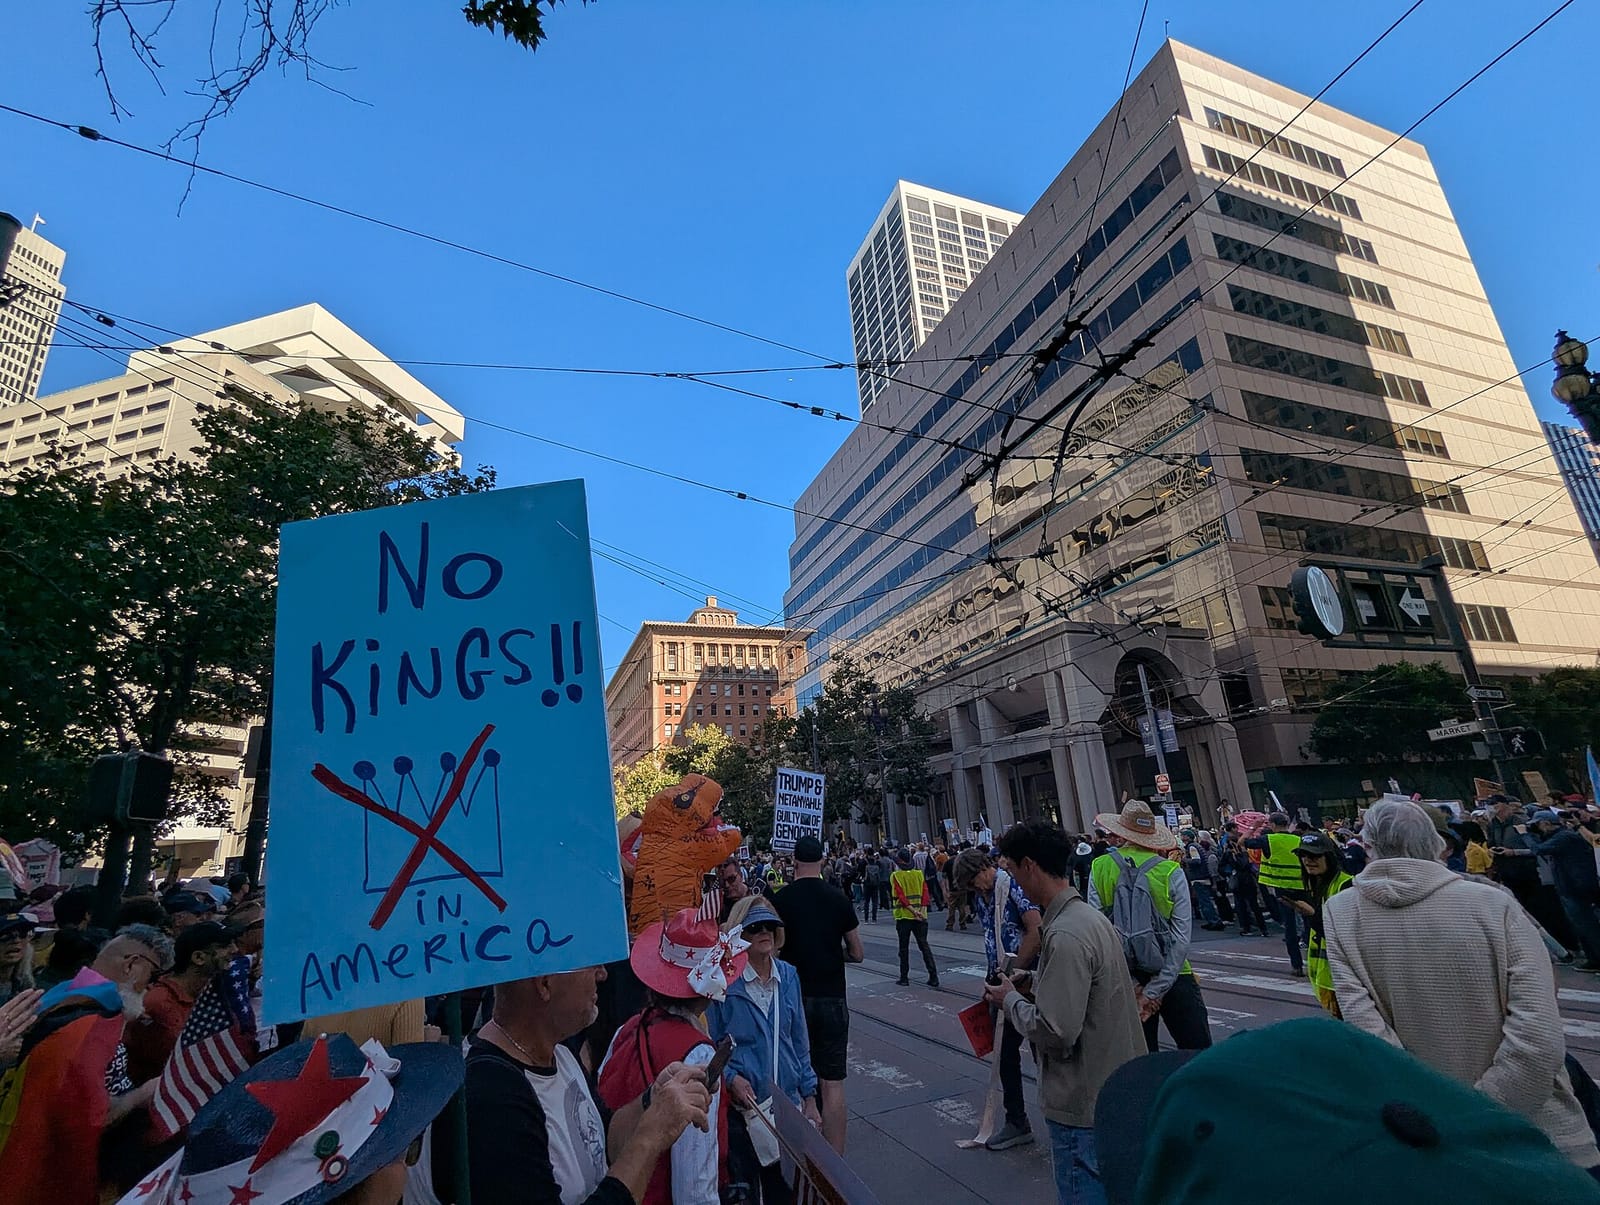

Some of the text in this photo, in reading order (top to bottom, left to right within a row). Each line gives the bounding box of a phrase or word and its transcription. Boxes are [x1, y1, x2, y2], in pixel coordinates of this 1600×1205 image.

[1436, 725, 1472, 737] MARKET
[779, 773, 823, 796] TRUMP &
[778, 793, 822, 811] NETANYAHU:
[776, 810, 821, 828] GUILTY OF
